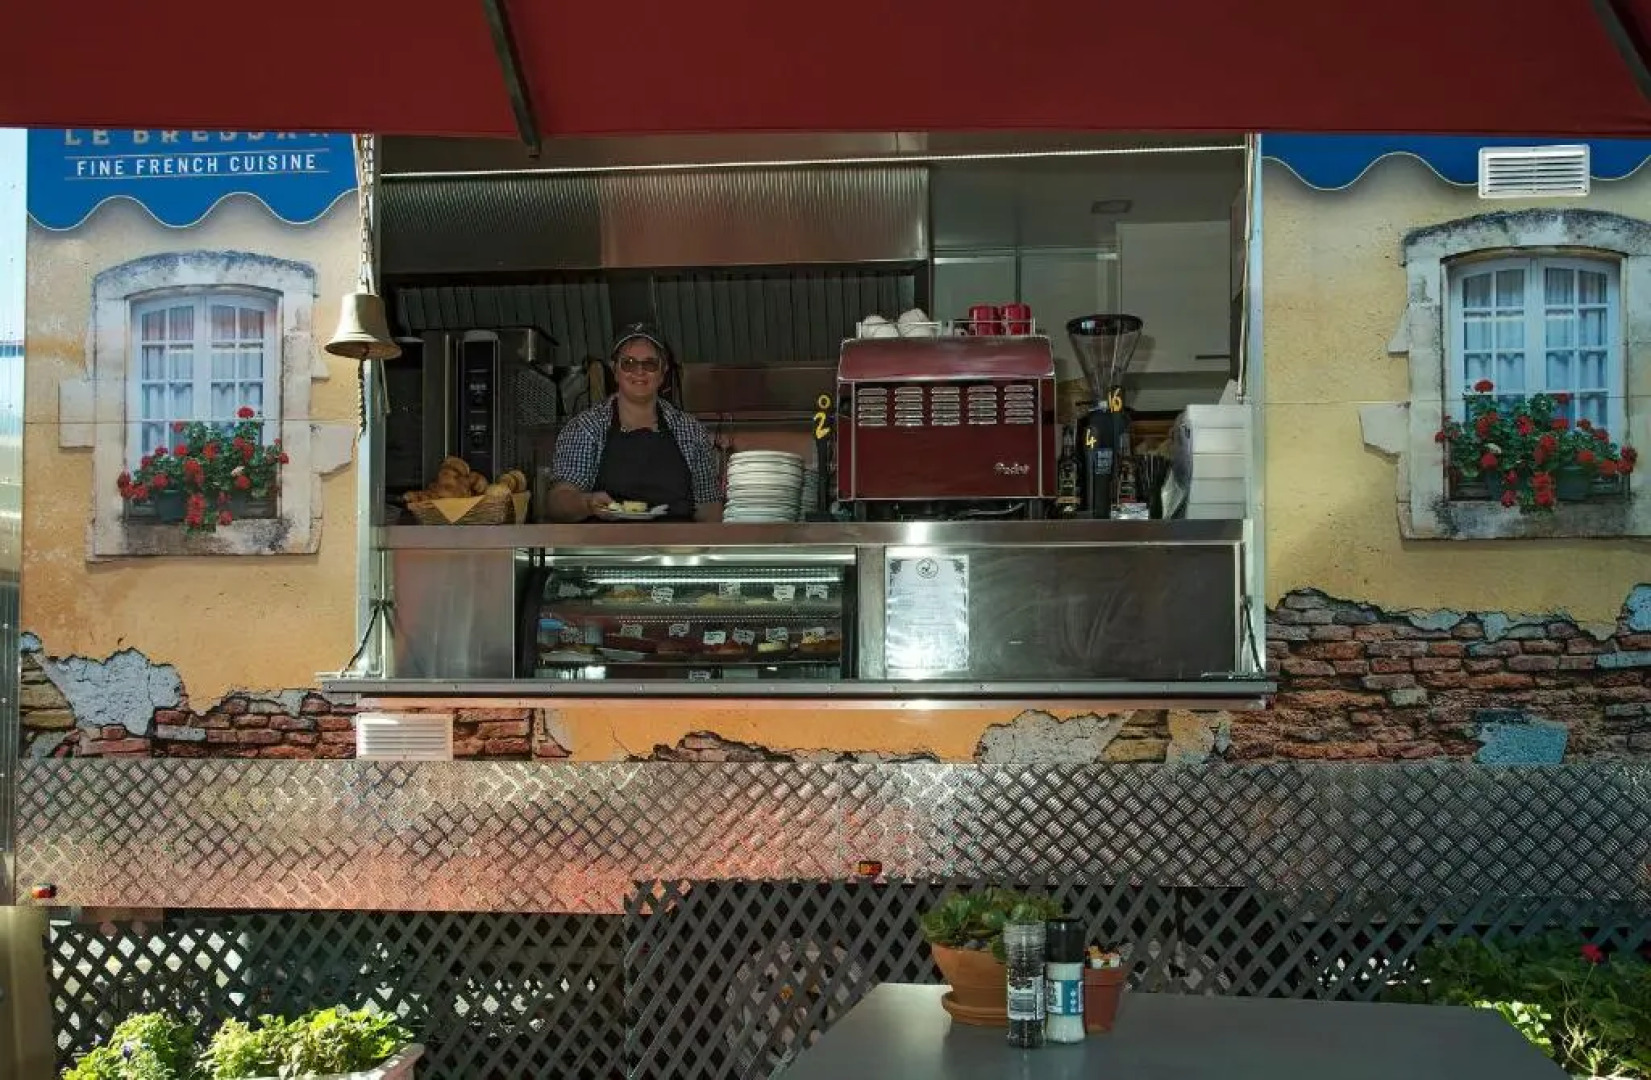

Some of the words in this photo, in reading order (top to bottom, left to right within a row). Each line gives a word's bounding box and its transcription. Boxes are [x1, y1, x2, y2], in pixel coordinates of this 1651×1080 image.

[65, 129, 110, 146] LE
[77, 160, 124, 176] FINE
[136, 157, 218, 175] FRENCH
[230, 154, 316, 172] CUISINE
